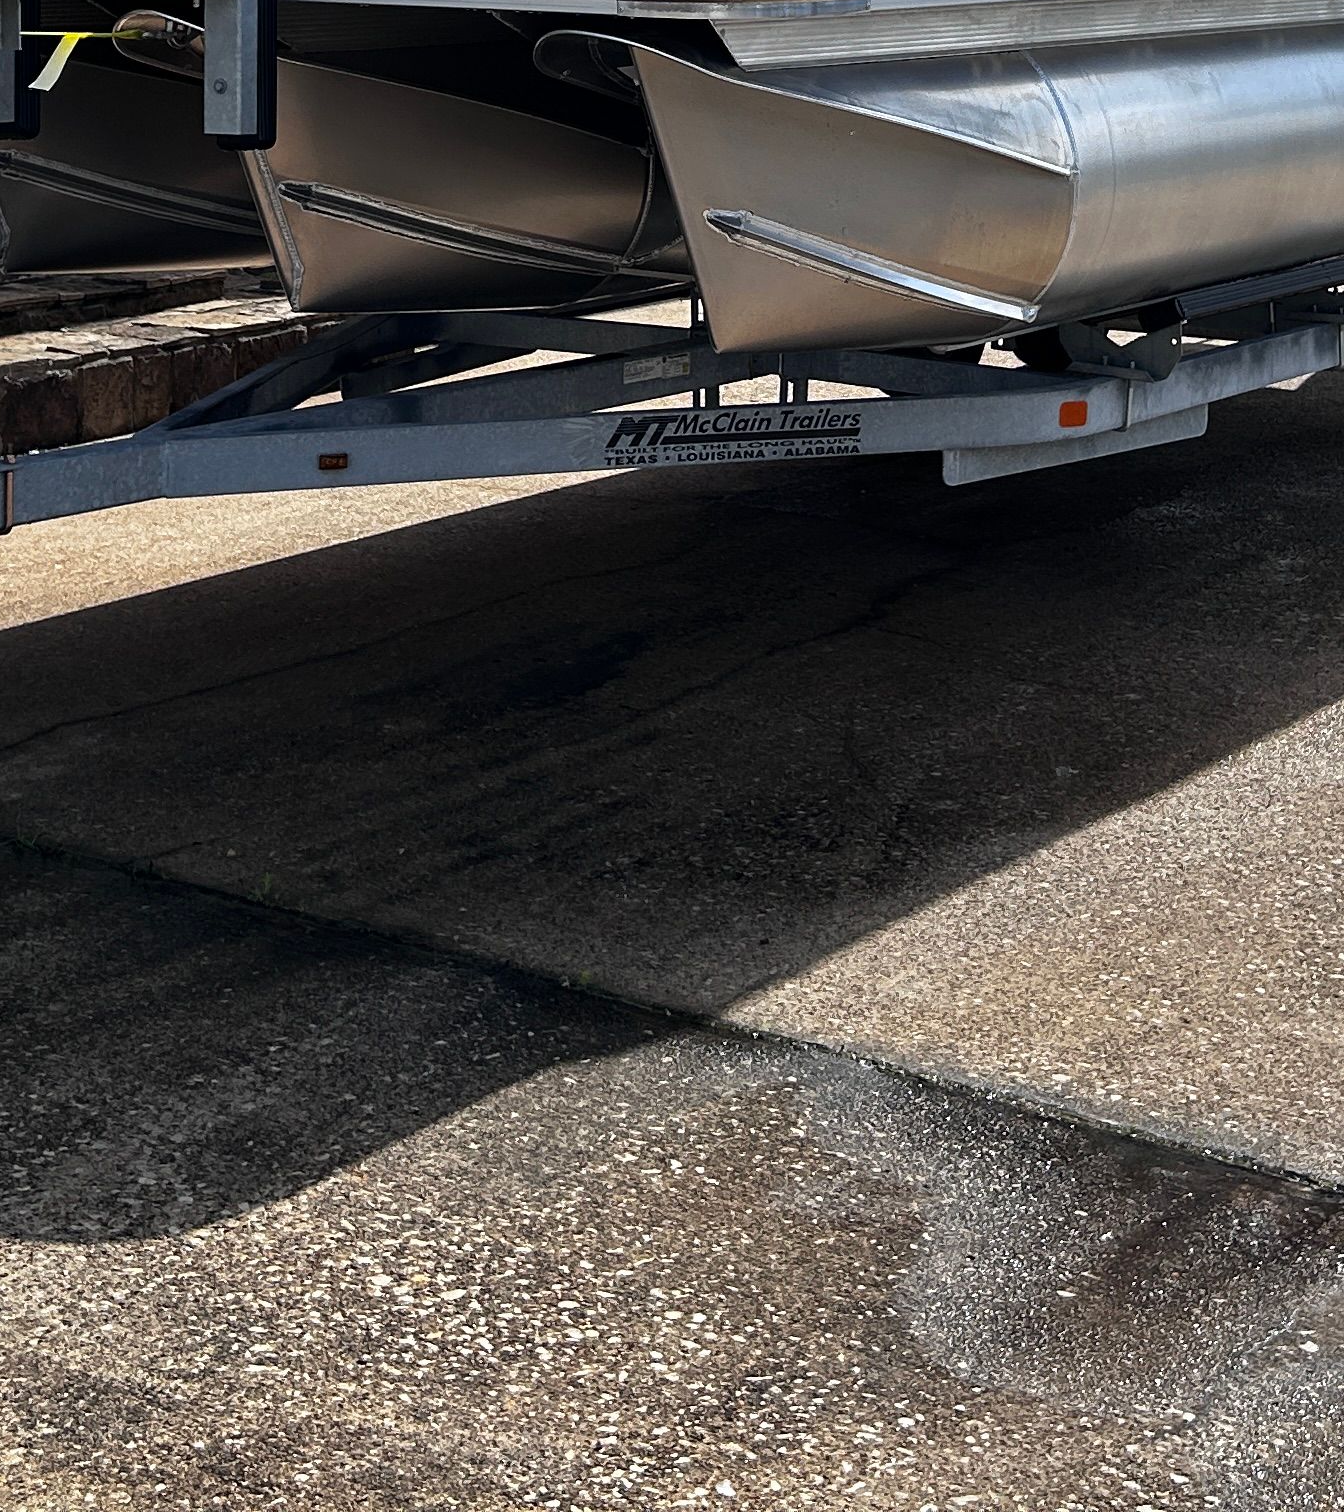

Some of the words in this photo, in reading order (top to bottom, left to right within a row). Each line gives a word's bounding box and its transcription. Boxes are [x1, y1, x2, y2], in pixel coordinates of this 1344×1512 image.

[673, 411, 772, 435] McClain
[780, 408, 862, 429] Trailers
[604, 454, 658, 466] TEXAS
[677, 449, 766, 463] LOUISIANA
[784, 445, 861, 457] ALABAMA
[663, 445, 697, 453] FOR
[702, 443, 730, 451] THE
[736, 440, 795, 449] LONG
